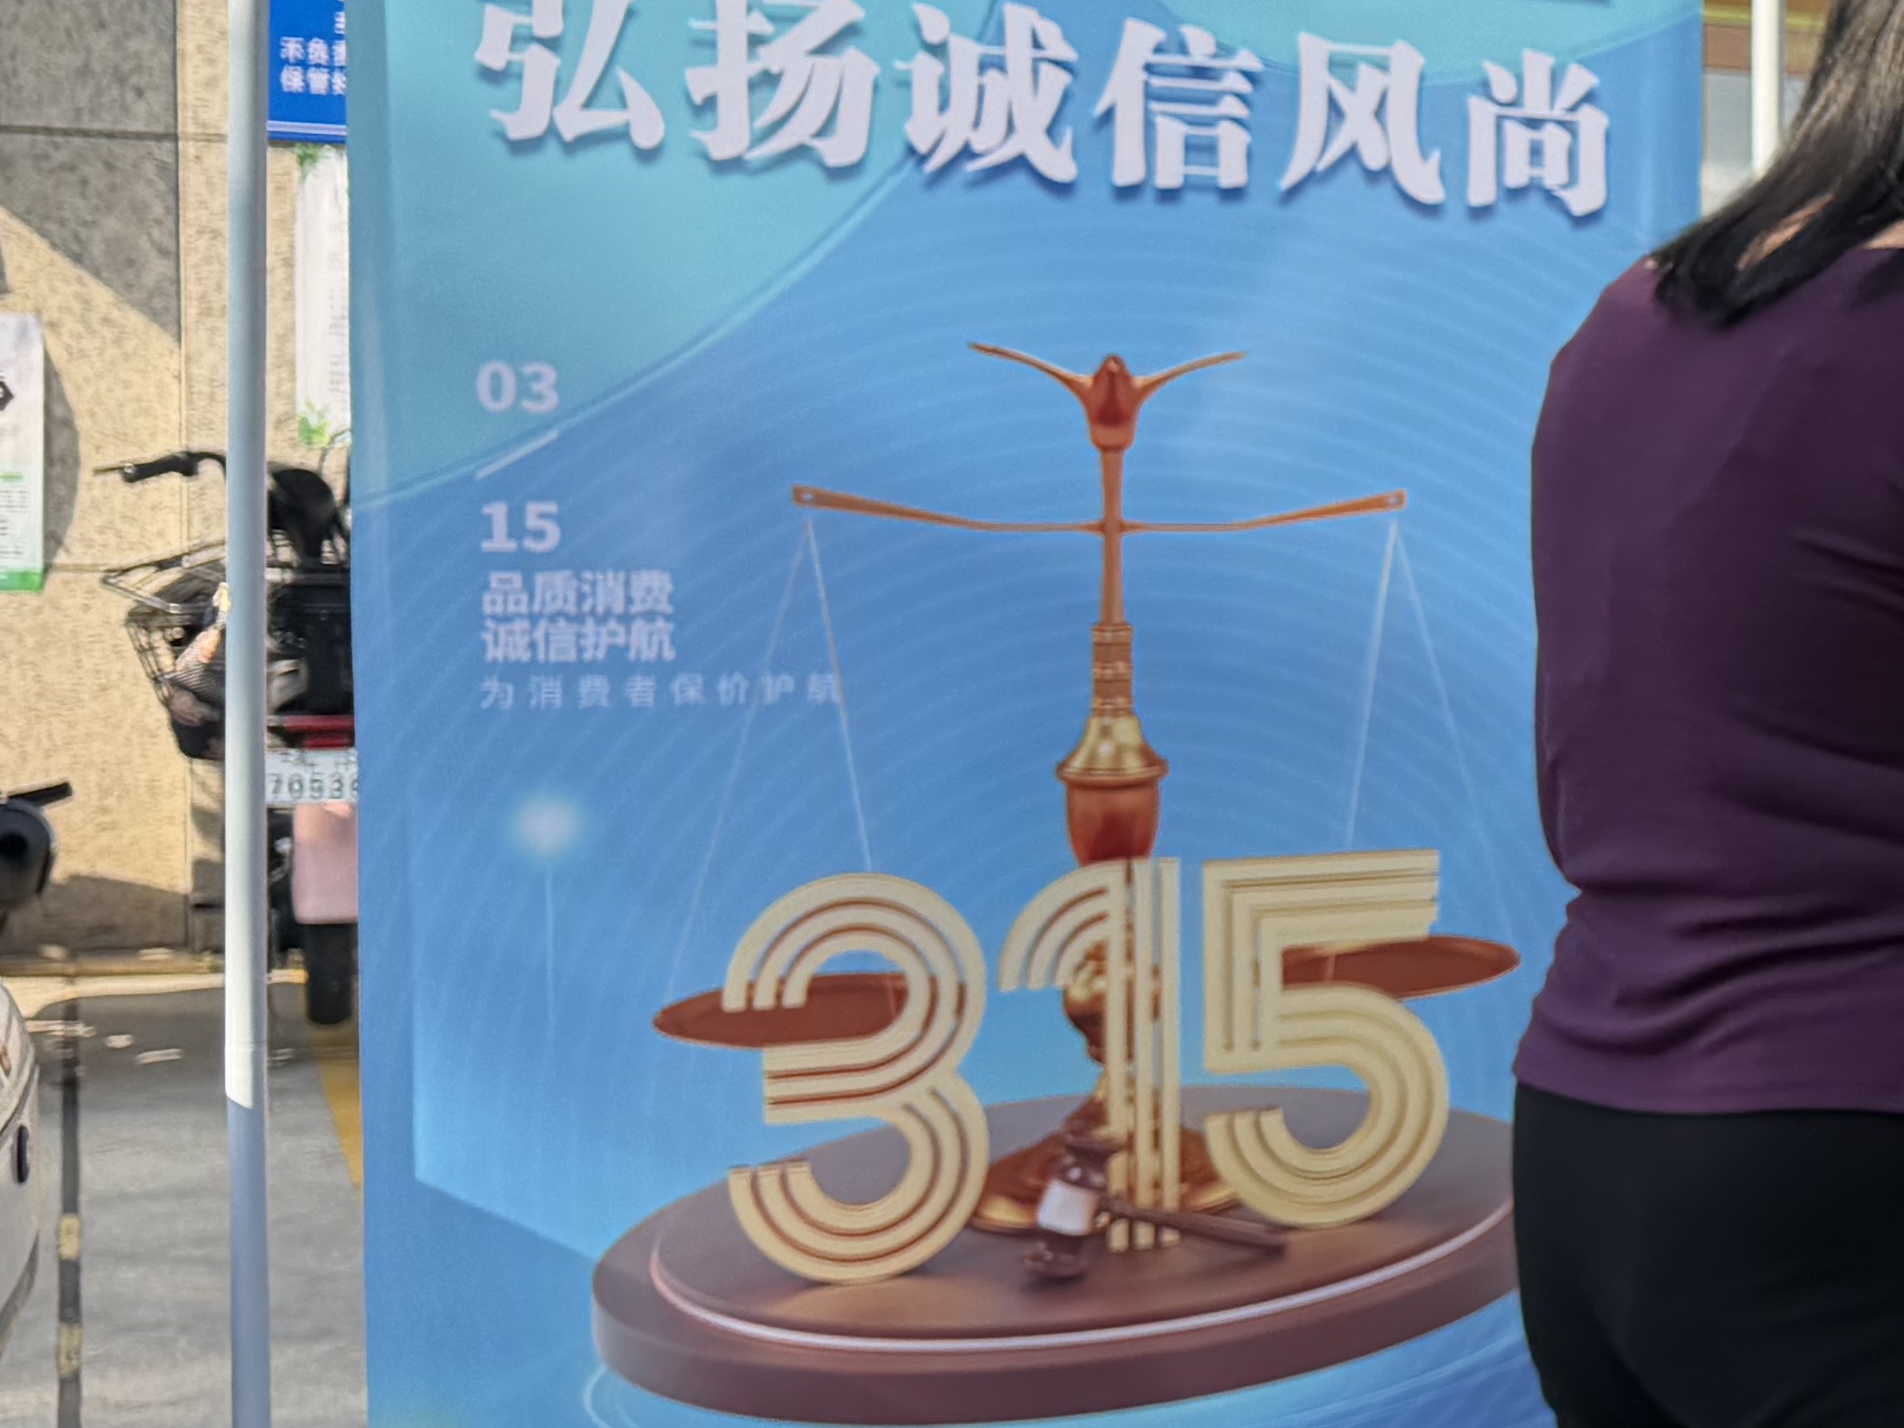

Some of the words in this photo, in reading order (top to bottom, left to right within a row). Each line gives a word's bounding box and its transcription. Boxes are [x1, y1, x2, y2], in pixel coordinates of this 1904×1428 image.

[476, 360, 560, 414] 03
[481, 502, 562, 553] 15
[481, 569, 674, 615] 品质消费
[481, 616, 676, 663] 诚信护航
[722, 849, 1450, 1286] 315
